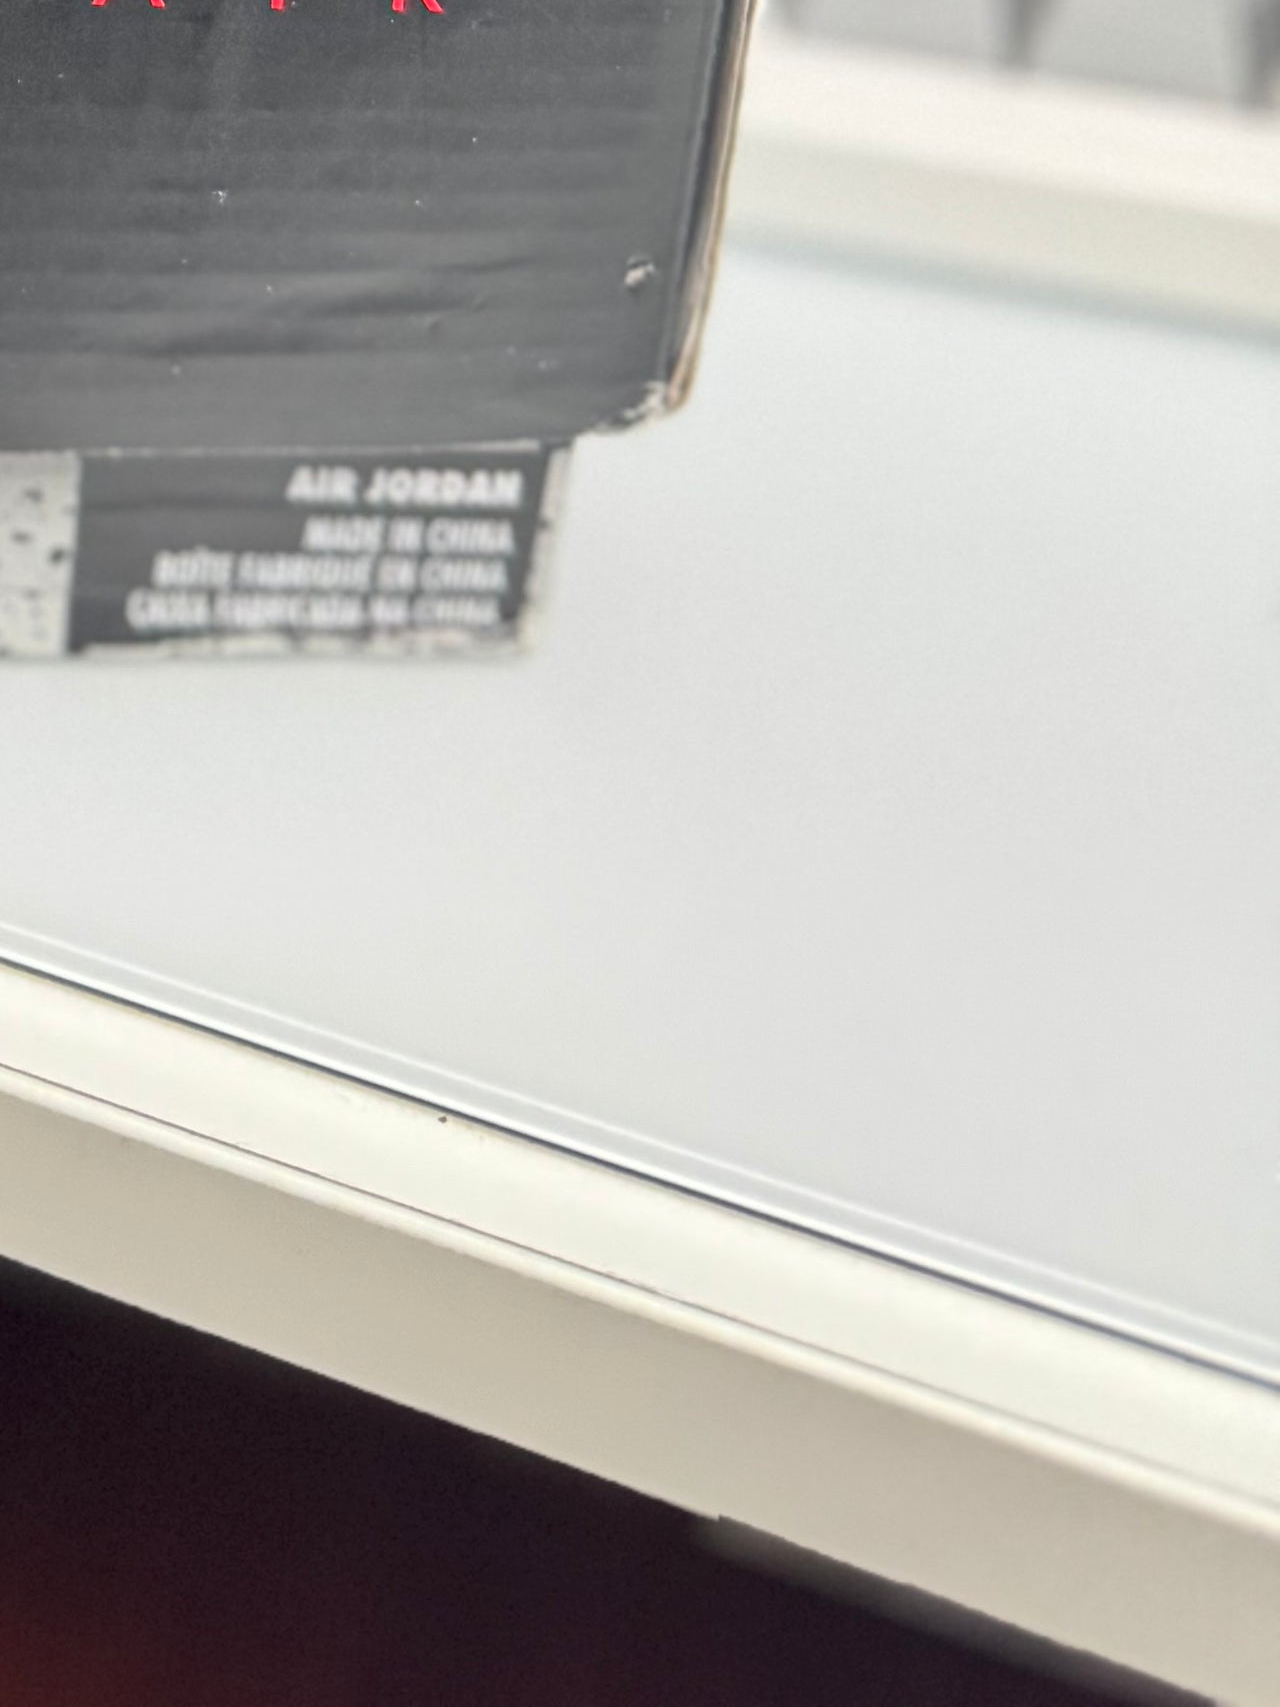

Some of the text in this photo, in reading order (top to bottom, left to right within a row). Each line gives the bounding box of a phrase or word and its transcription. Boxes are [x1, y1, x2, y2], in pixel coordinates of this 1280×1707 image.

[285, 464, 524, 510] AIR JORDAN
[425, 516, 515, 556] CHINA
